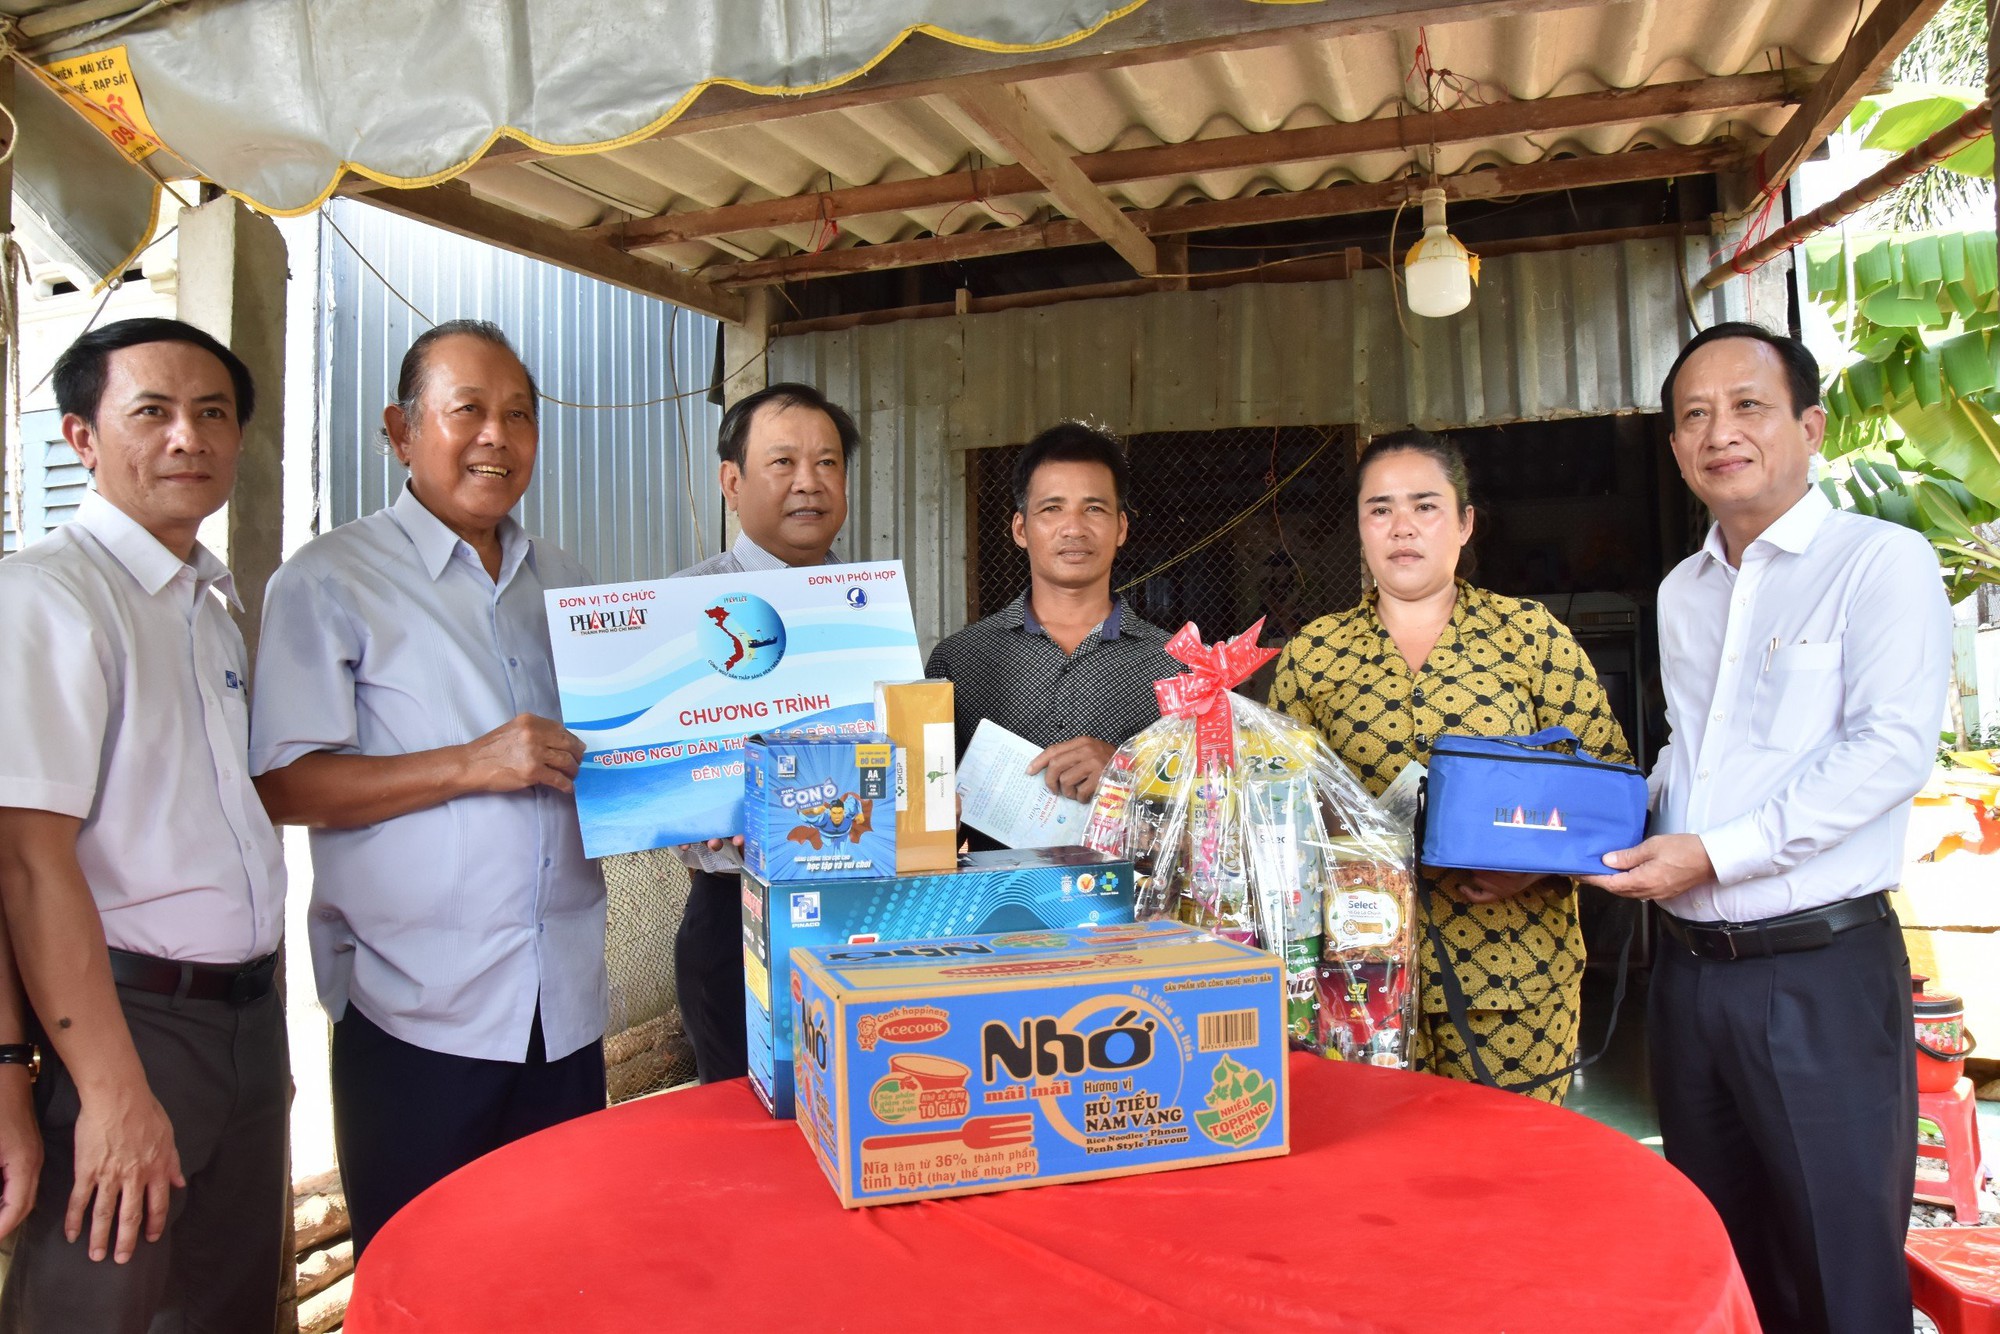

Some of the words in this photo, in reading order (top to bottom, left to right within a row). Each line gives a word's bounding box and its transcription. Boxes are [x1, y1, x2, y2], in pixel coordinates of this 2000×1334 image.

[874, 570, 896, 581] HỢP
[559, 596, 586, 608] ĐƠN
[589, 595, 601, 607] VỊ
[622, 589, 656, 601] CHỨC
[679, 701, 769, 726] CHƯƠNG
[773, 694, 831, 714] TRÌNH
[649, 744, 684, 760] NGƯ
[687, 739, 719, 756] DÂN
[725, 761, 744, 779] VỚ
[868, 770, 878, 778] AA
[782, 786, 823, 808] CON
[834, 861, 842, 870] và
[1348, 900, 1378, 910] Select
[877, 1009, 900, 1023] Cook
[902, 1006, 948, 1019] happiness
[984, 1010, 1155, 1082] Nhớ
[985, 1086, 1024, 1102] mãi
[1031, 1082, 1070, 1097] mãi
[1085, 1080, 1118, 1094] Hương
[1123, 1077, 1132, 1091] vị
[939, 1100, 966, 1116] GIẤY
[1085, 1096, 1111, 1116] HỦ
[1116, 1090, 1158, 1113] TIẾU
[1086, 1116, 1126, 1132] NAM
[1131, 1108, 1183, 1127] VANG
[1209, 1101, 1269, 1137] TOPPING
[1086, 1137, 1106, 1145] Rice
[1108, 1133, 1143, 1143] Noodles
[1151, 1127, 1187, 1137] Phnom
[1232, 1122, 1258, 1139] HƠN
[1087, 1145, 1114, 1154] Penh
[1116, 1140, 1144, 1151] Style
[1147, 1135, 1189, 1146] Flavour
[894, 1159, 915, 1171] làm
[920, 1158, 931, 1169] từ
[935, 1154, 967, 1168] 36%
[974, 1150, 1005, 1163] thành
[1008, 1147, 1036, 1163] phần
[863, 1175, 891, 1190] tinh
[899, 1171, 923, 1187] bột
[927, 1170, 956, 1185] (thay
[961, 1165, 980, 1179] thế
[984, 1163, 1012, 1177] nhựa
[1016, 1161, 1037, 1174] PP)
